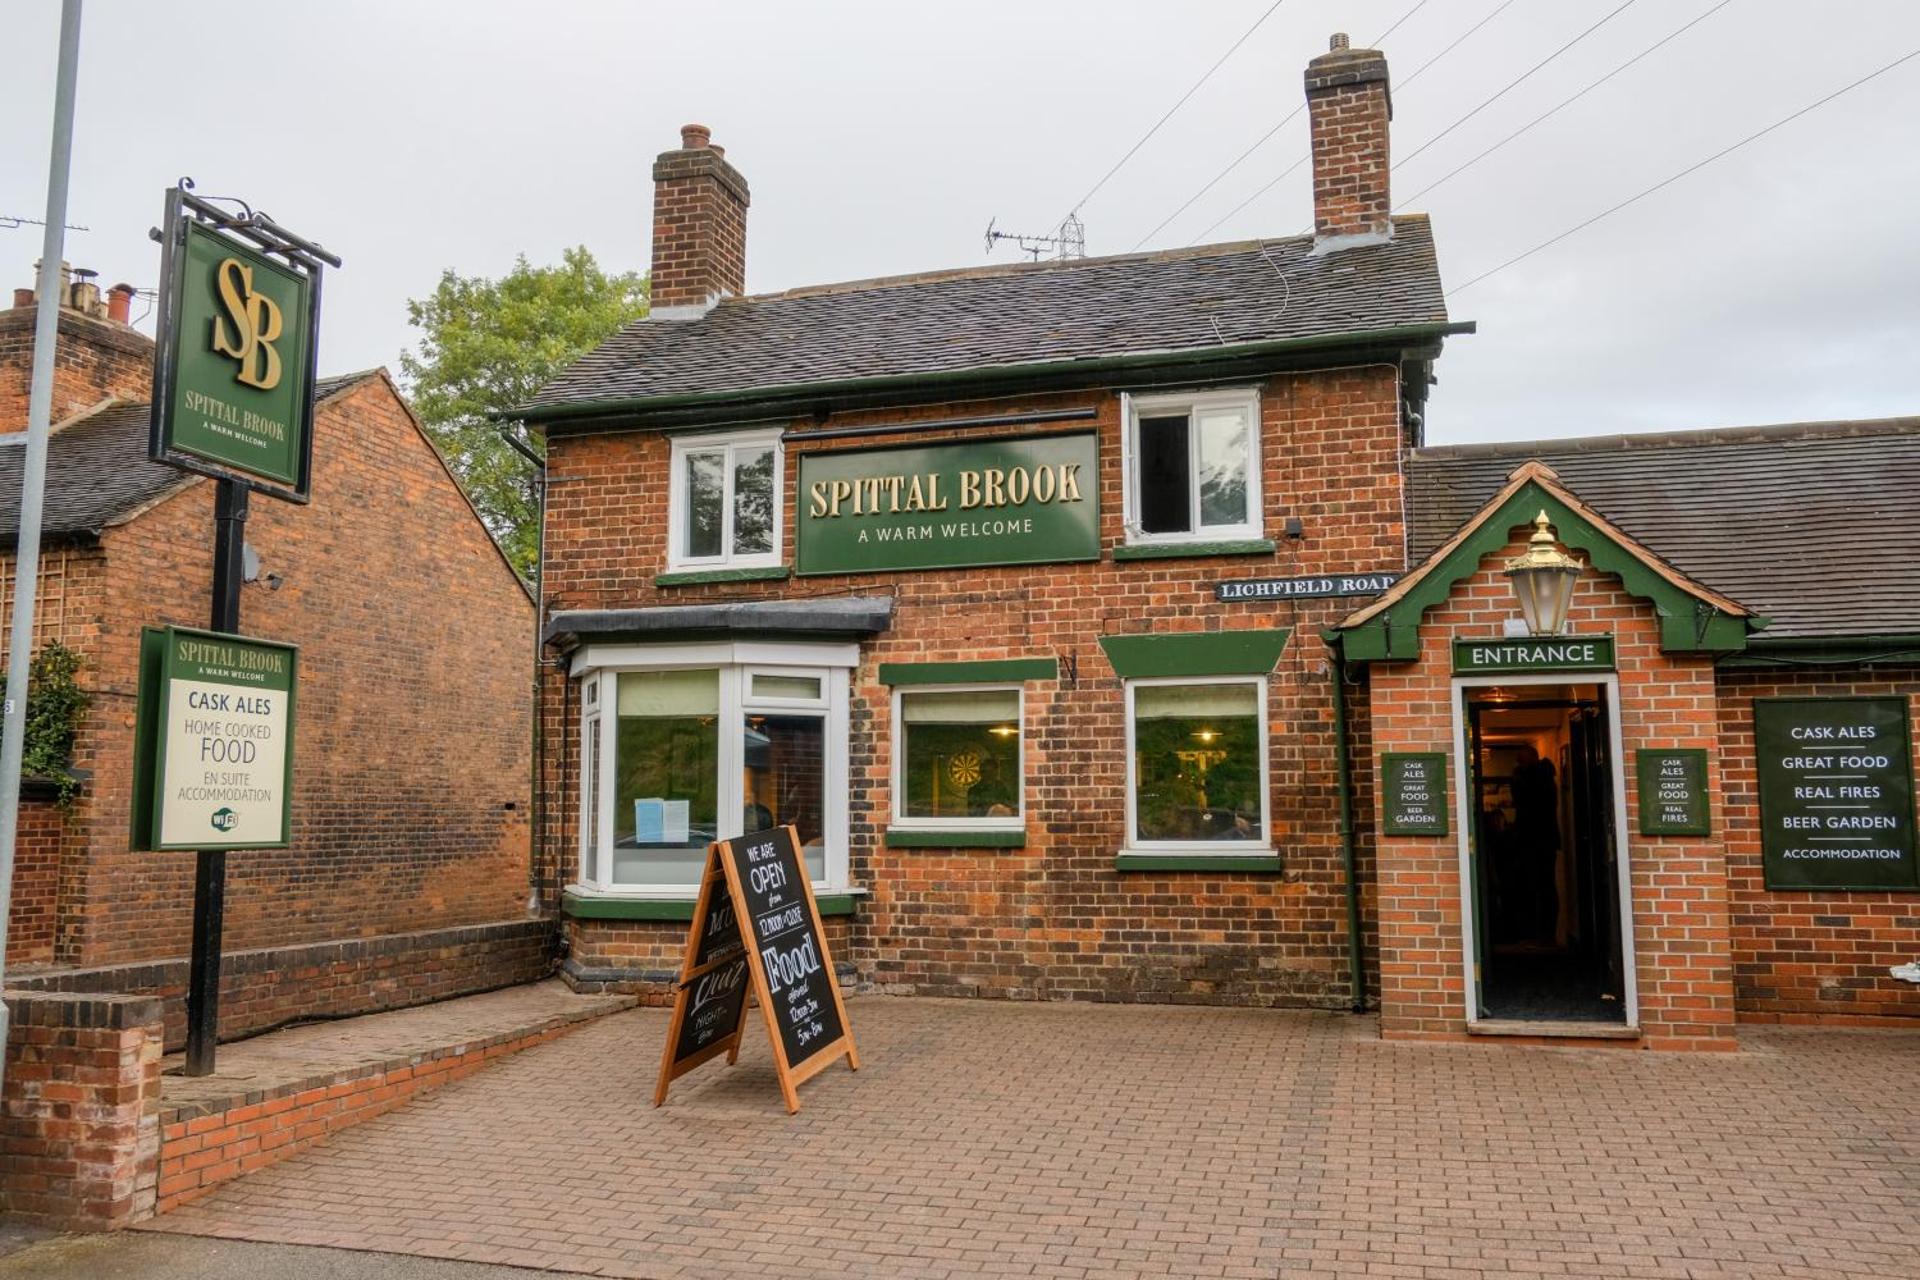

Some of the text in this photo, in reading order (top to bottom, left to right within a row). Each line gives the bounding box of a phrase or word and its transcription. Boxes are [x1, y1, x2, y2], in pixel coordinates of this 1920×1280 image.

[185, 390, 285, 443] SPITTAL BROOK
[202, 421, 268, 450] A WARM WELCOME
[810, 462, 1083, 518] SPITTAL BROOK
[858, 519, 1033, 543] A WARM WELCOME
[1221, 576, 1395, 598] LICHFIELD ROAD
[179, 640, 284, 674] SPITTAL BROOK
[1472, 644, 1595, 665] ENTRANCE
[205, 667, 230, 678] WARM
[231, 670, 265, 682] WELCOME
[188, 691, 271, 715] CASK ALES
[184, 719, 271, 740] HOME COOKED
[1791, 726, 1876, 739] CASK ALES
[201, 737, 256, 764] FOOD
[1782, 756, 1888, 769] GREAT FOOD
[204, 772, 250, 786] EN SUITE
[1403, 770, 1425, 778] ALES
[1660, 767, 1684, 776] ALES
[1660, 782, 1685, 790] GREAT
[1794, 786, 1880, 799] REAL FIRES
[178, 787, 272, 802] ACCOMMODATION
[1400, 793, 1429, 801] FOOD
[1658, 790, 1689, 799] FOOD
[1395, 814, 1436, 823] GARDEN
[1662, 814, 1688, 823] FIRES
[1783, 816, 1896, 829] BEER GARDEN
[746, 842, 777, 864] WE ARE
[1783, 849, 1901, 859] ACCOMMODATION
[750, 861, 787, 894] OPEN
[762, 932, 821, 994] Food
